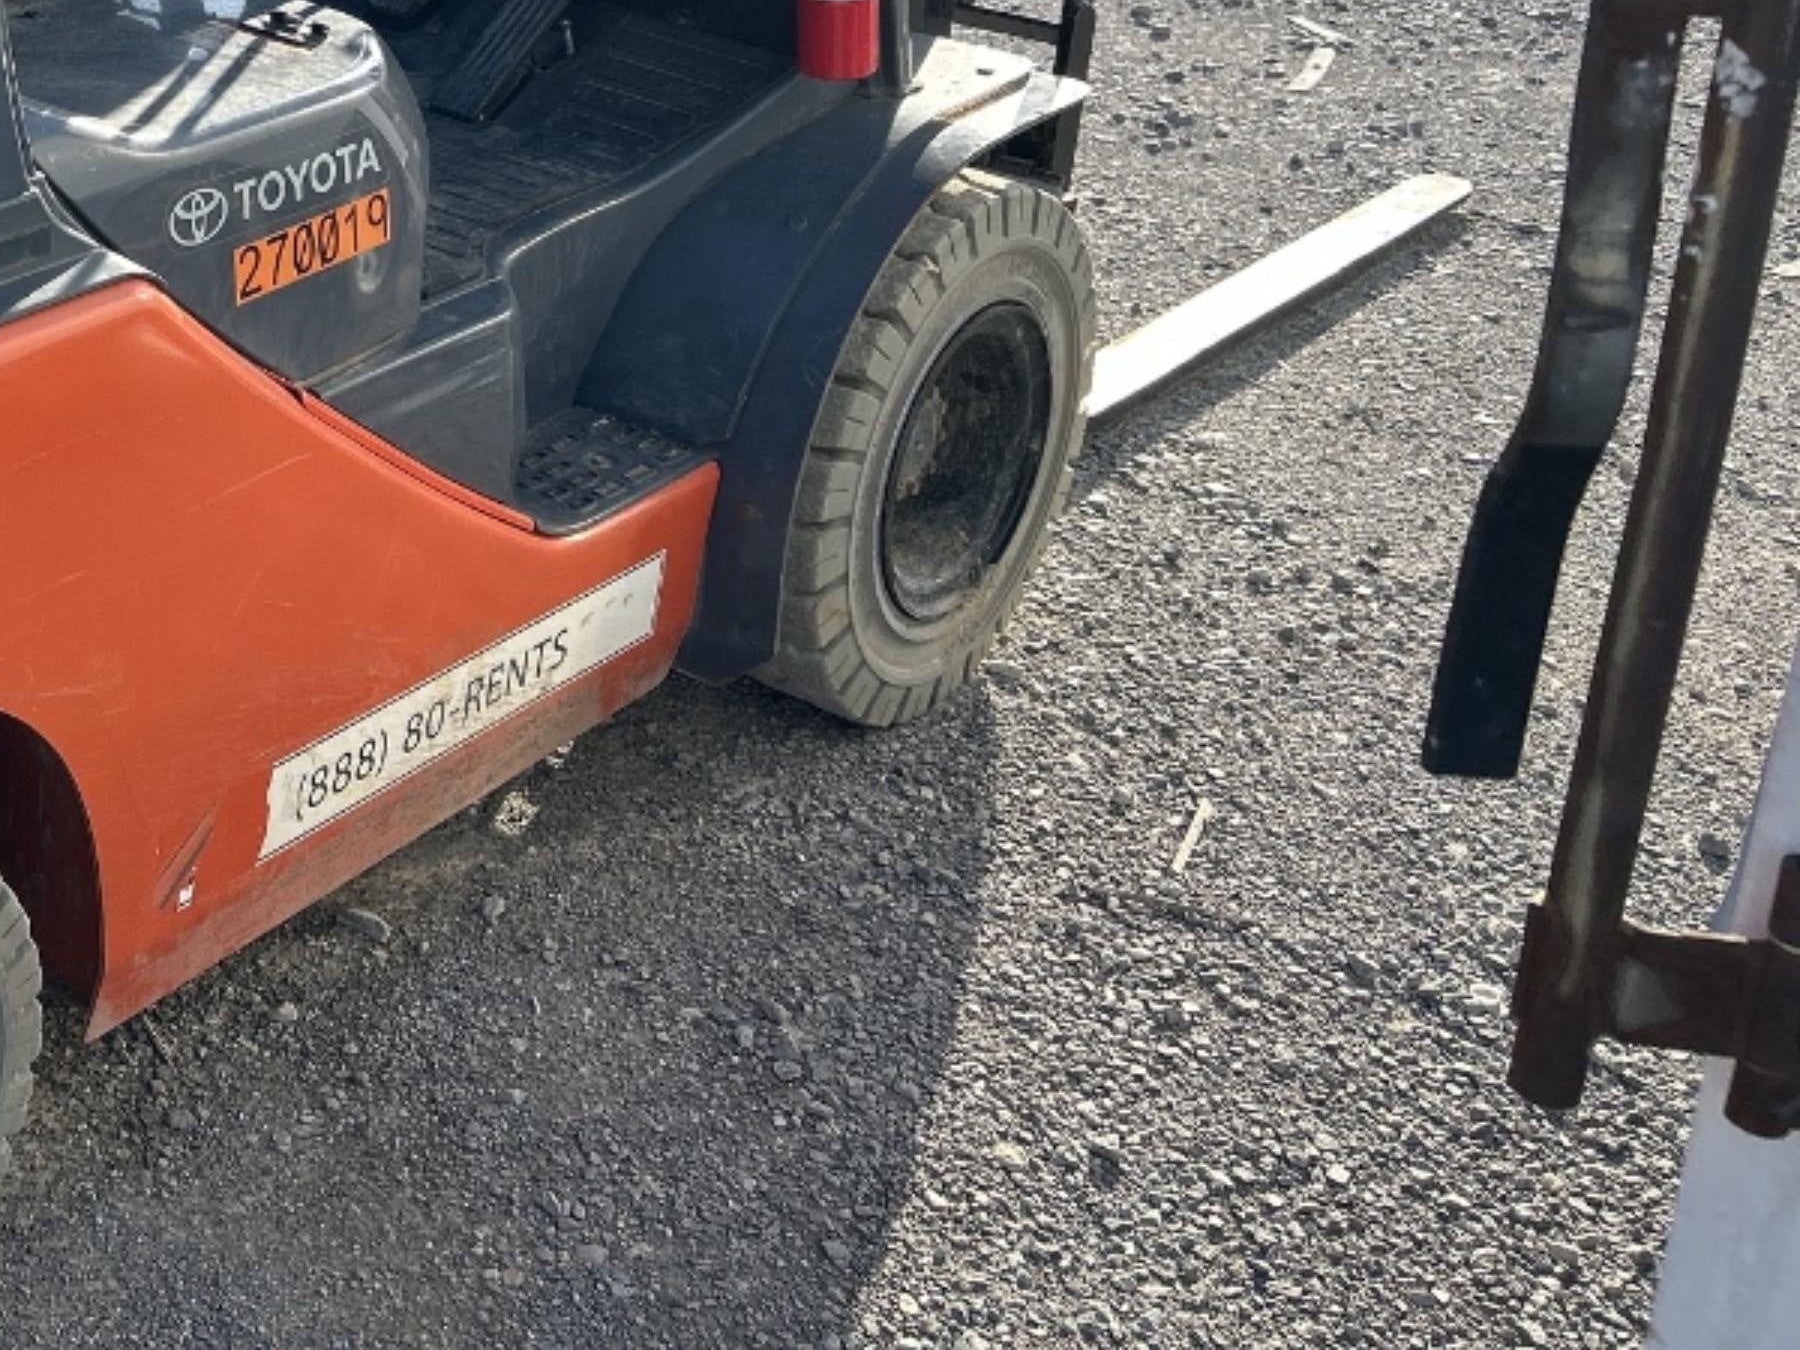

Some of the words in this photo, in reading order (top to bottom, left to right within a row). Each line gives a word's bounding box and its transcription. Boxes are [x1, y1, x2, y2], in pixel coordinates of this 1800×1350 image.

[233, 137, 383, 220] TOYOTA
[238, 194, 388, 301] 270019
[295, 728, 389, 823] (888)
[402, 627, 570, 755] 80-RENTS
